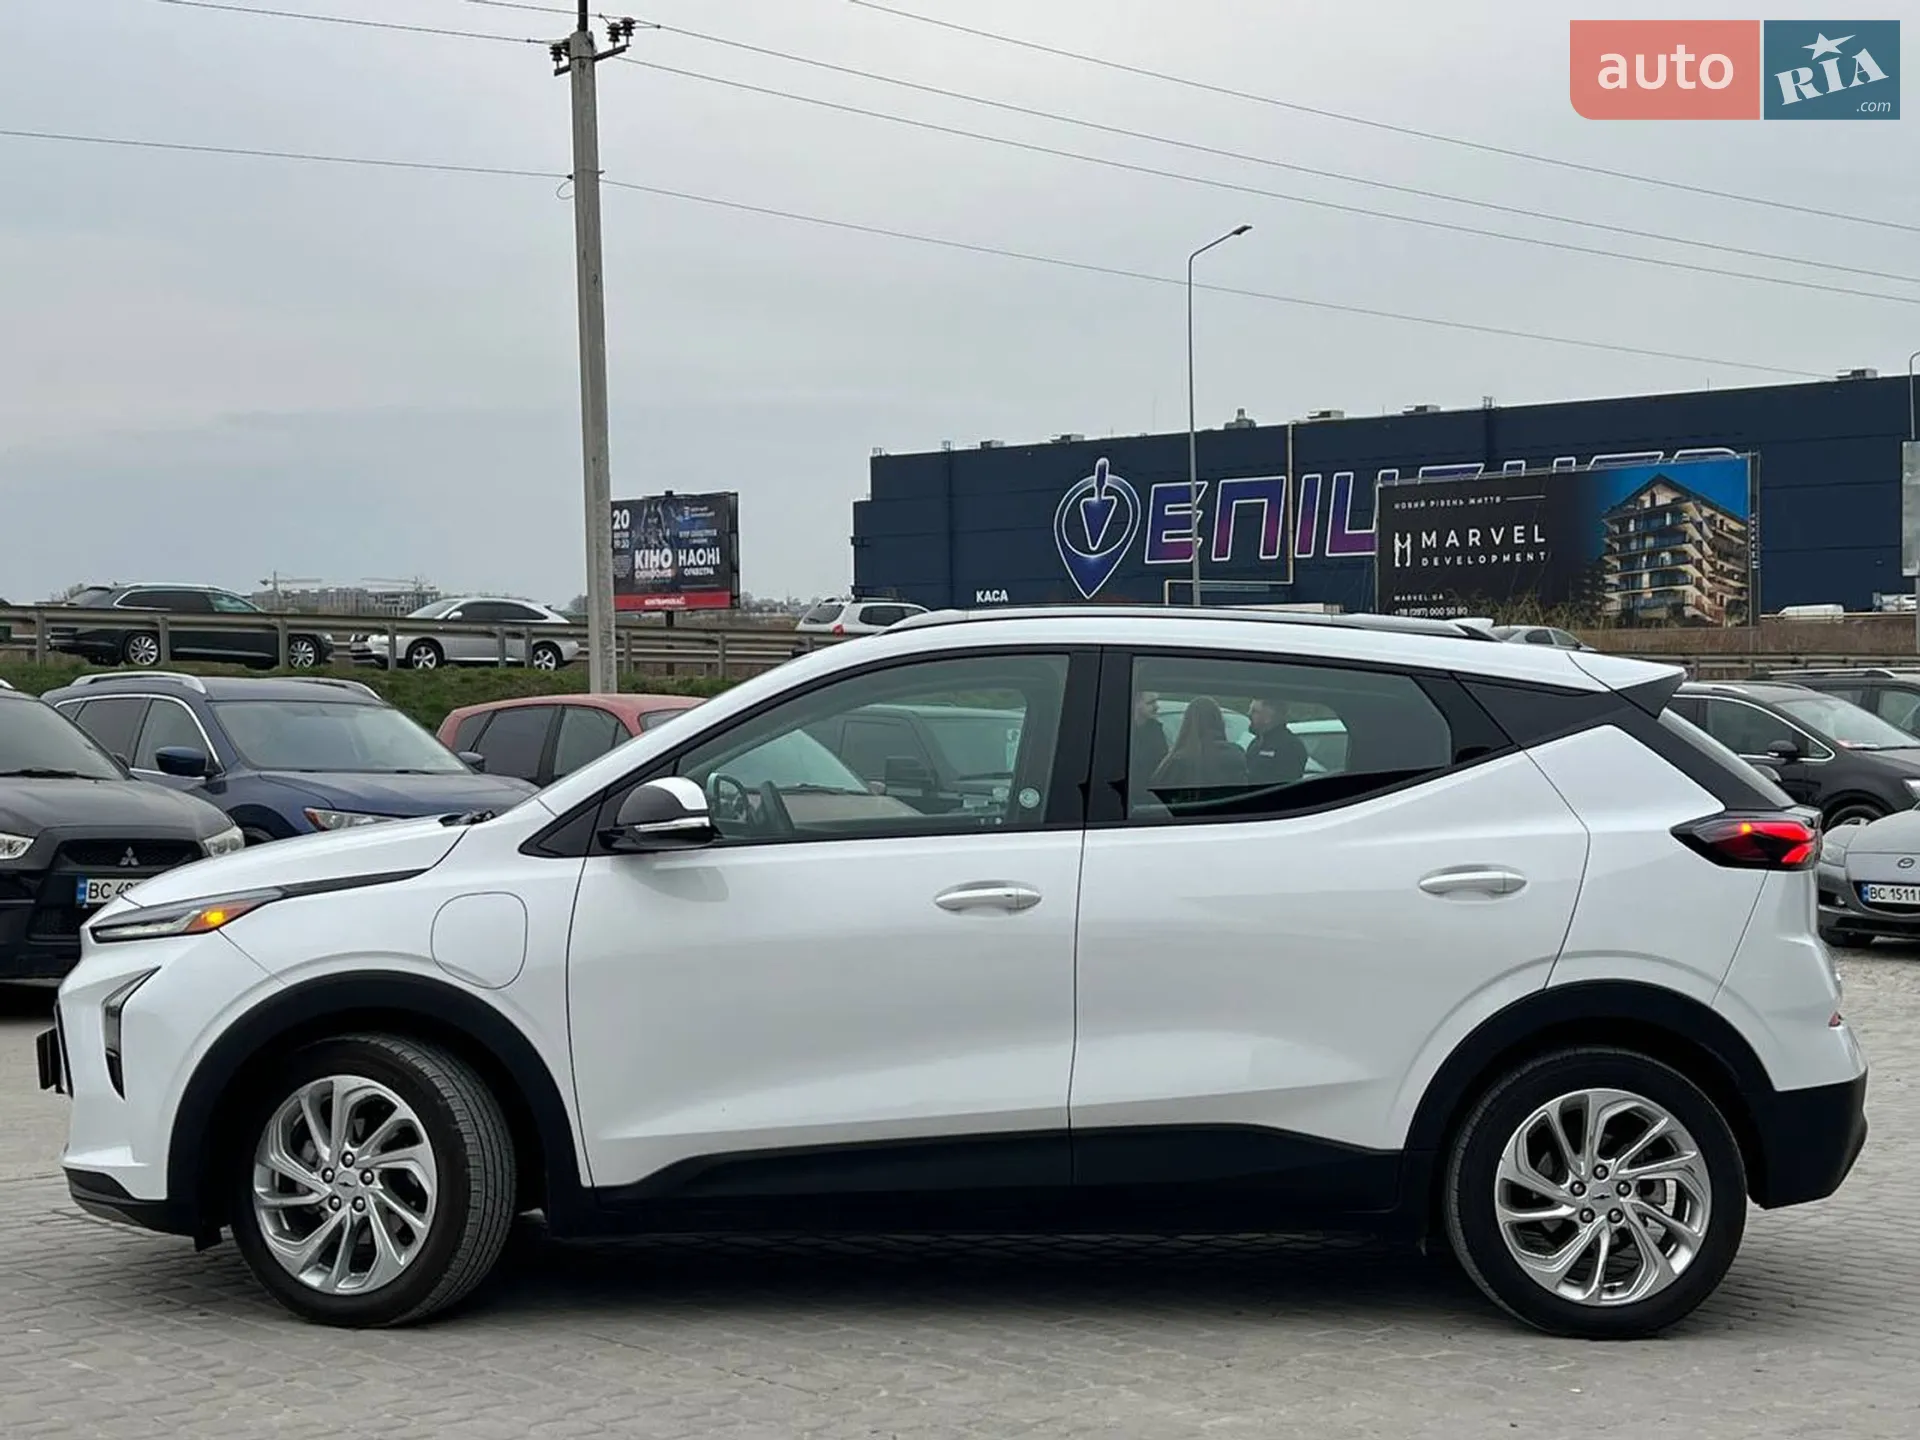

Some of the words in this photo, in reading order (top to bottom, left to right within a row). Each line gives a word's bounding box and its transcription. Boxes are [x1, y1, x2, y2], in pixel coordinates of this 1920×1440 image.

[612, 509, 630, 529] 20
[1421, 525, 1546, 549] MARVEL
[634, 548, 673, 569] КІНО
[678, 548, 720, 567] НАОНІ
[1421, 552, 1546, 567] DEVELOPMENT
[976, 589, 1009, 603] КАСА
[88, 882, 112, 899] BC
[1870, 887, 1886, 900] BC
[1890, 888, 1916, 901] 1511
